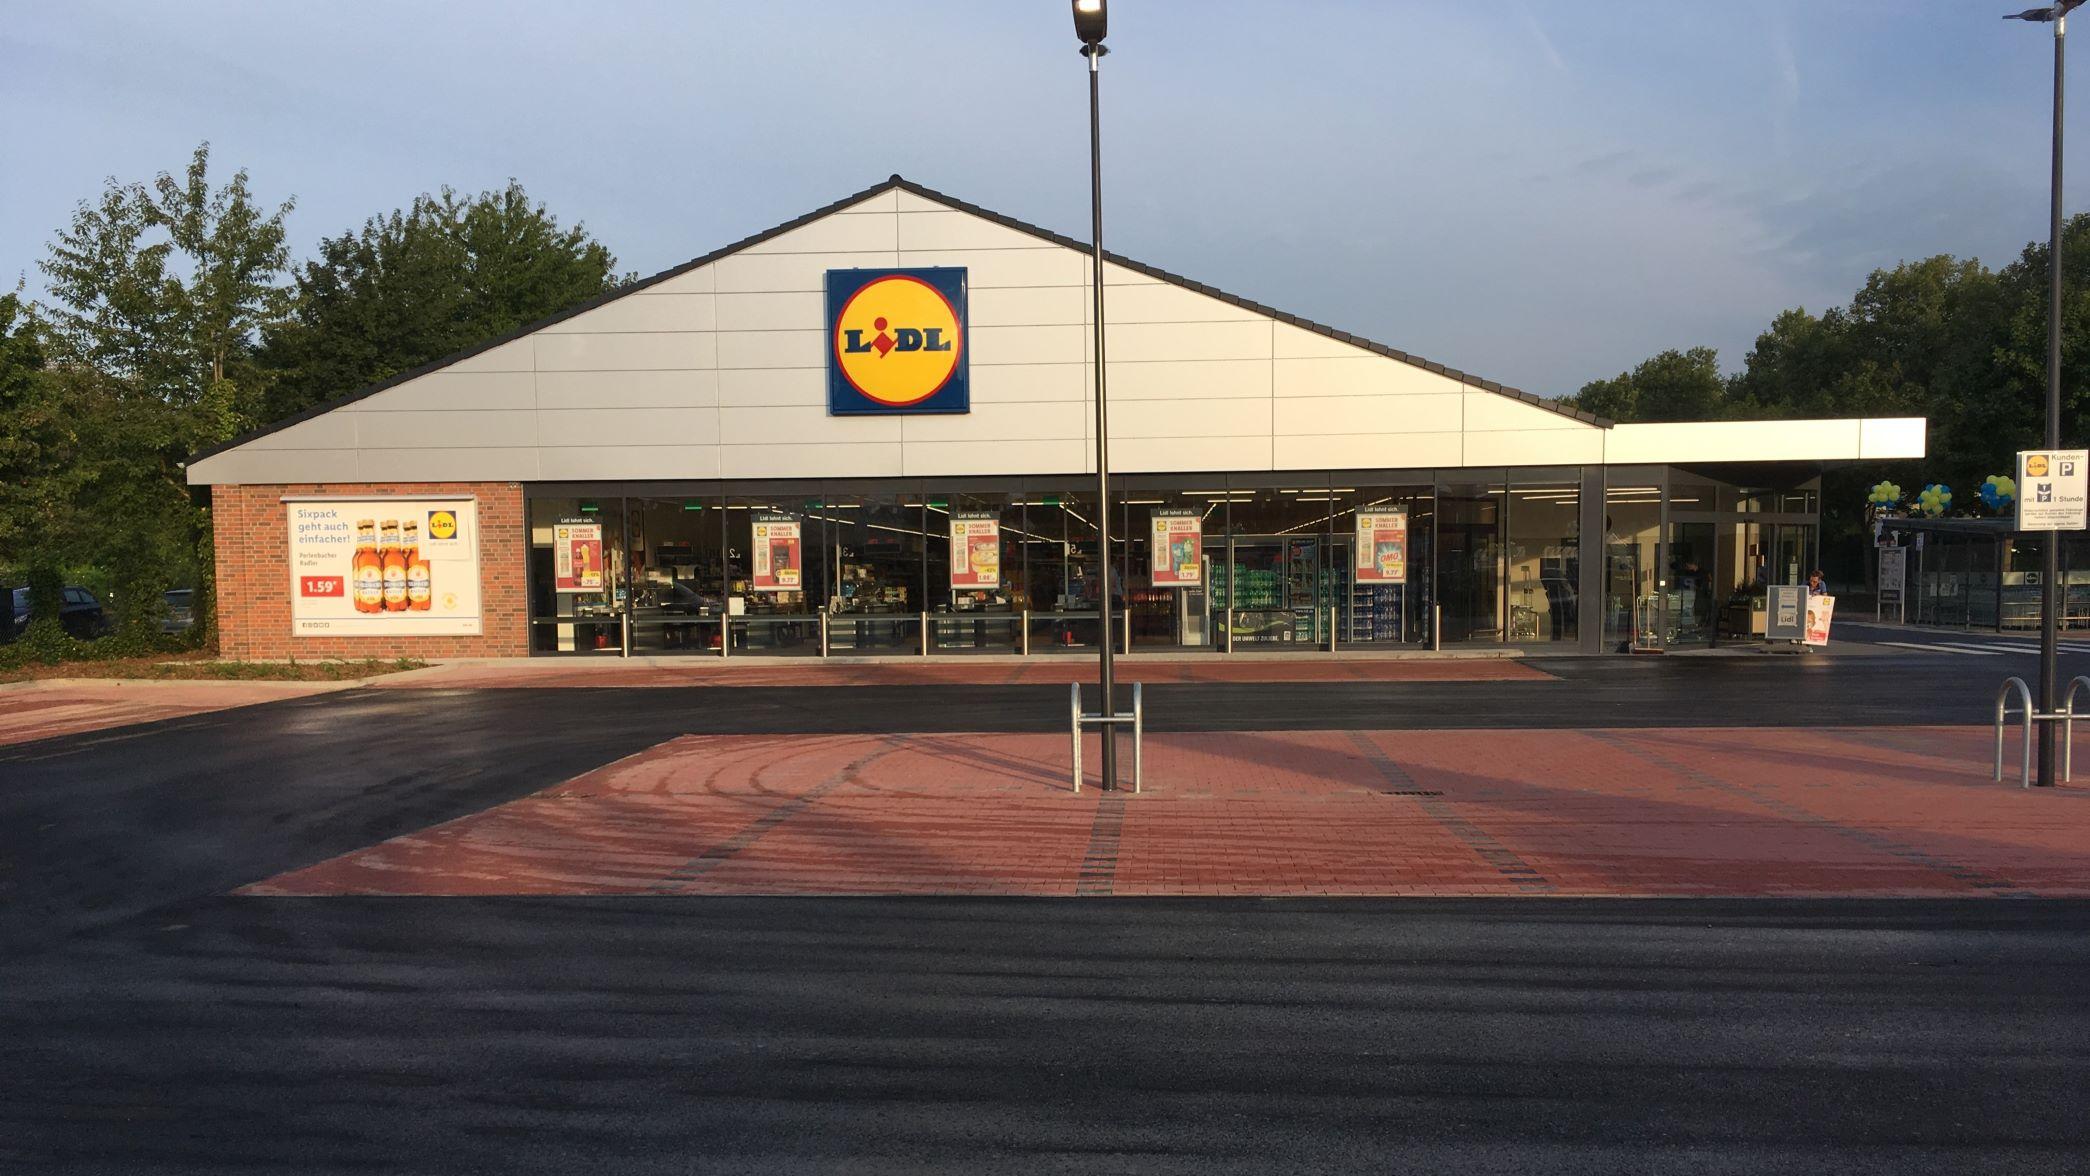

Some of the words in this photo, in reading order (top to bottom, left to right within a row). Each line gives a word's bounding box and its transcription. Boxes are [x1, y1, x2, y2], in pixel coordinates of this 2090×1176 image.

[2062, 463, 2072, 476] P
[298, 509, 337, 520] Sixpack
[298, 522, 320, 532] geht
[324, 522, 348, 531] auch
[298, 535, 350, 543] einfacher!
[1381, 552, 1398, 562] OMO
